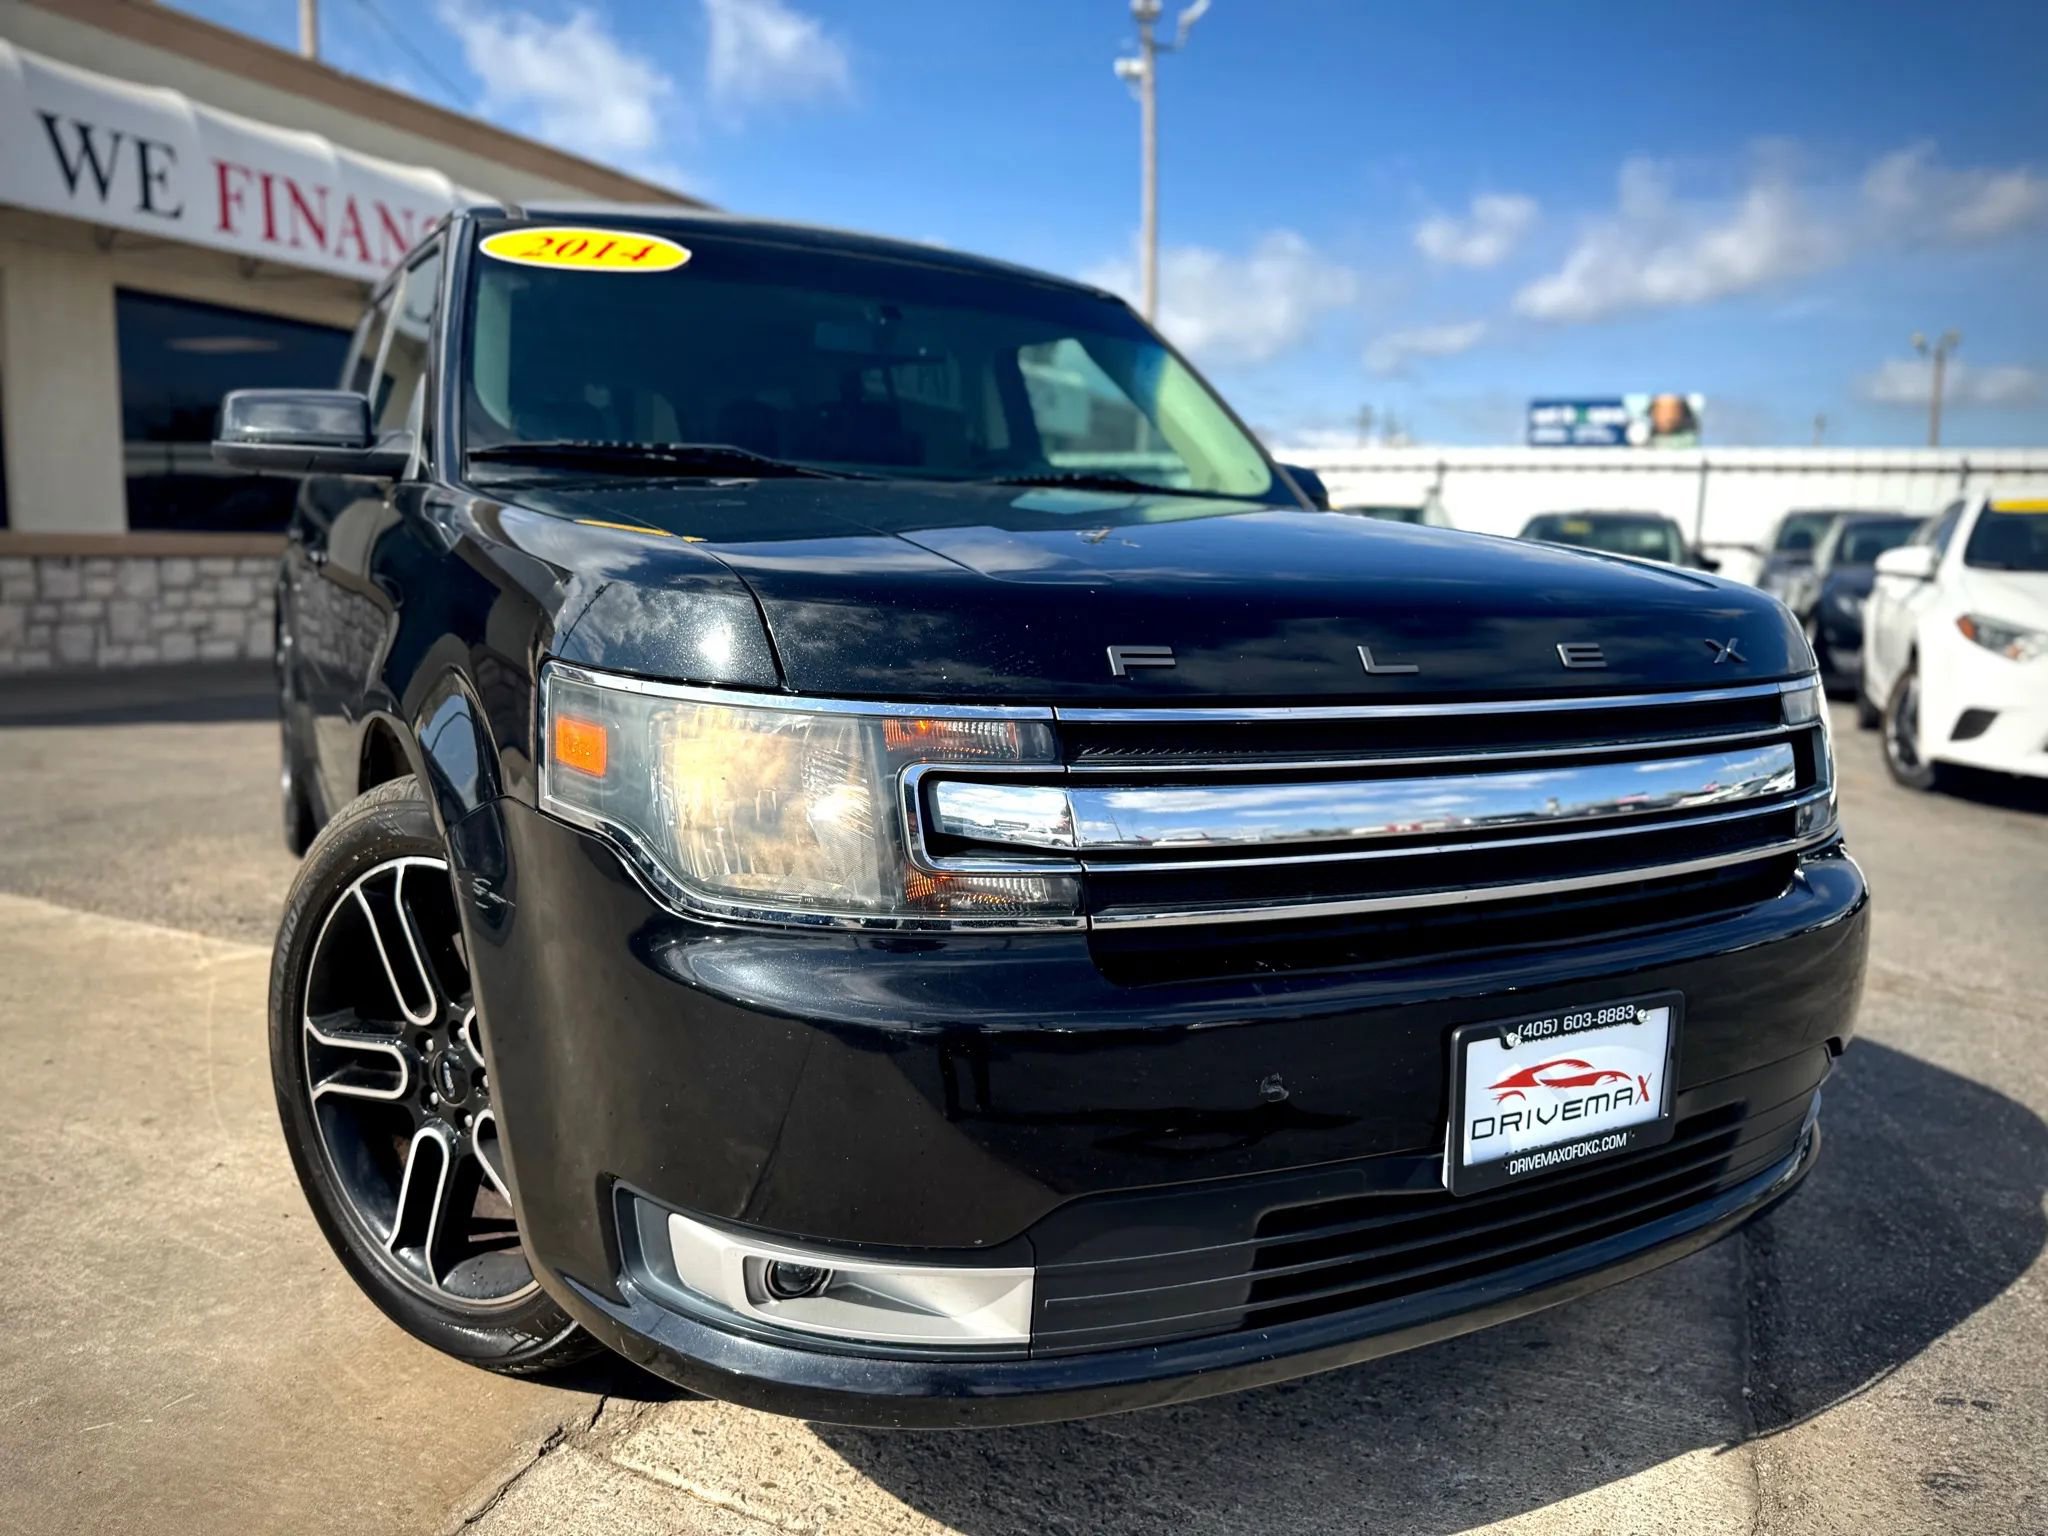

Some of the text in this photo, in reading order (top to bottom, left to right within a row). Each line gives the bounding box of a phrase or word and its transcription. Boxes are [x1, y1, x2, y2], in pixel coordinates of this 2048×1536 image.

[36, 109, 184, 220] WE
[518, 236, 658, 262] 2014
[1106, 638, 1748, 676] FLEX
[1518, 1004, 1635, 1039] (405) 603-8883
[1471, 1072, 1652, 1141] DRIVEMAX
[1509, 1132, 1627, 1176] DRIVEMAXOFOKC.COM
